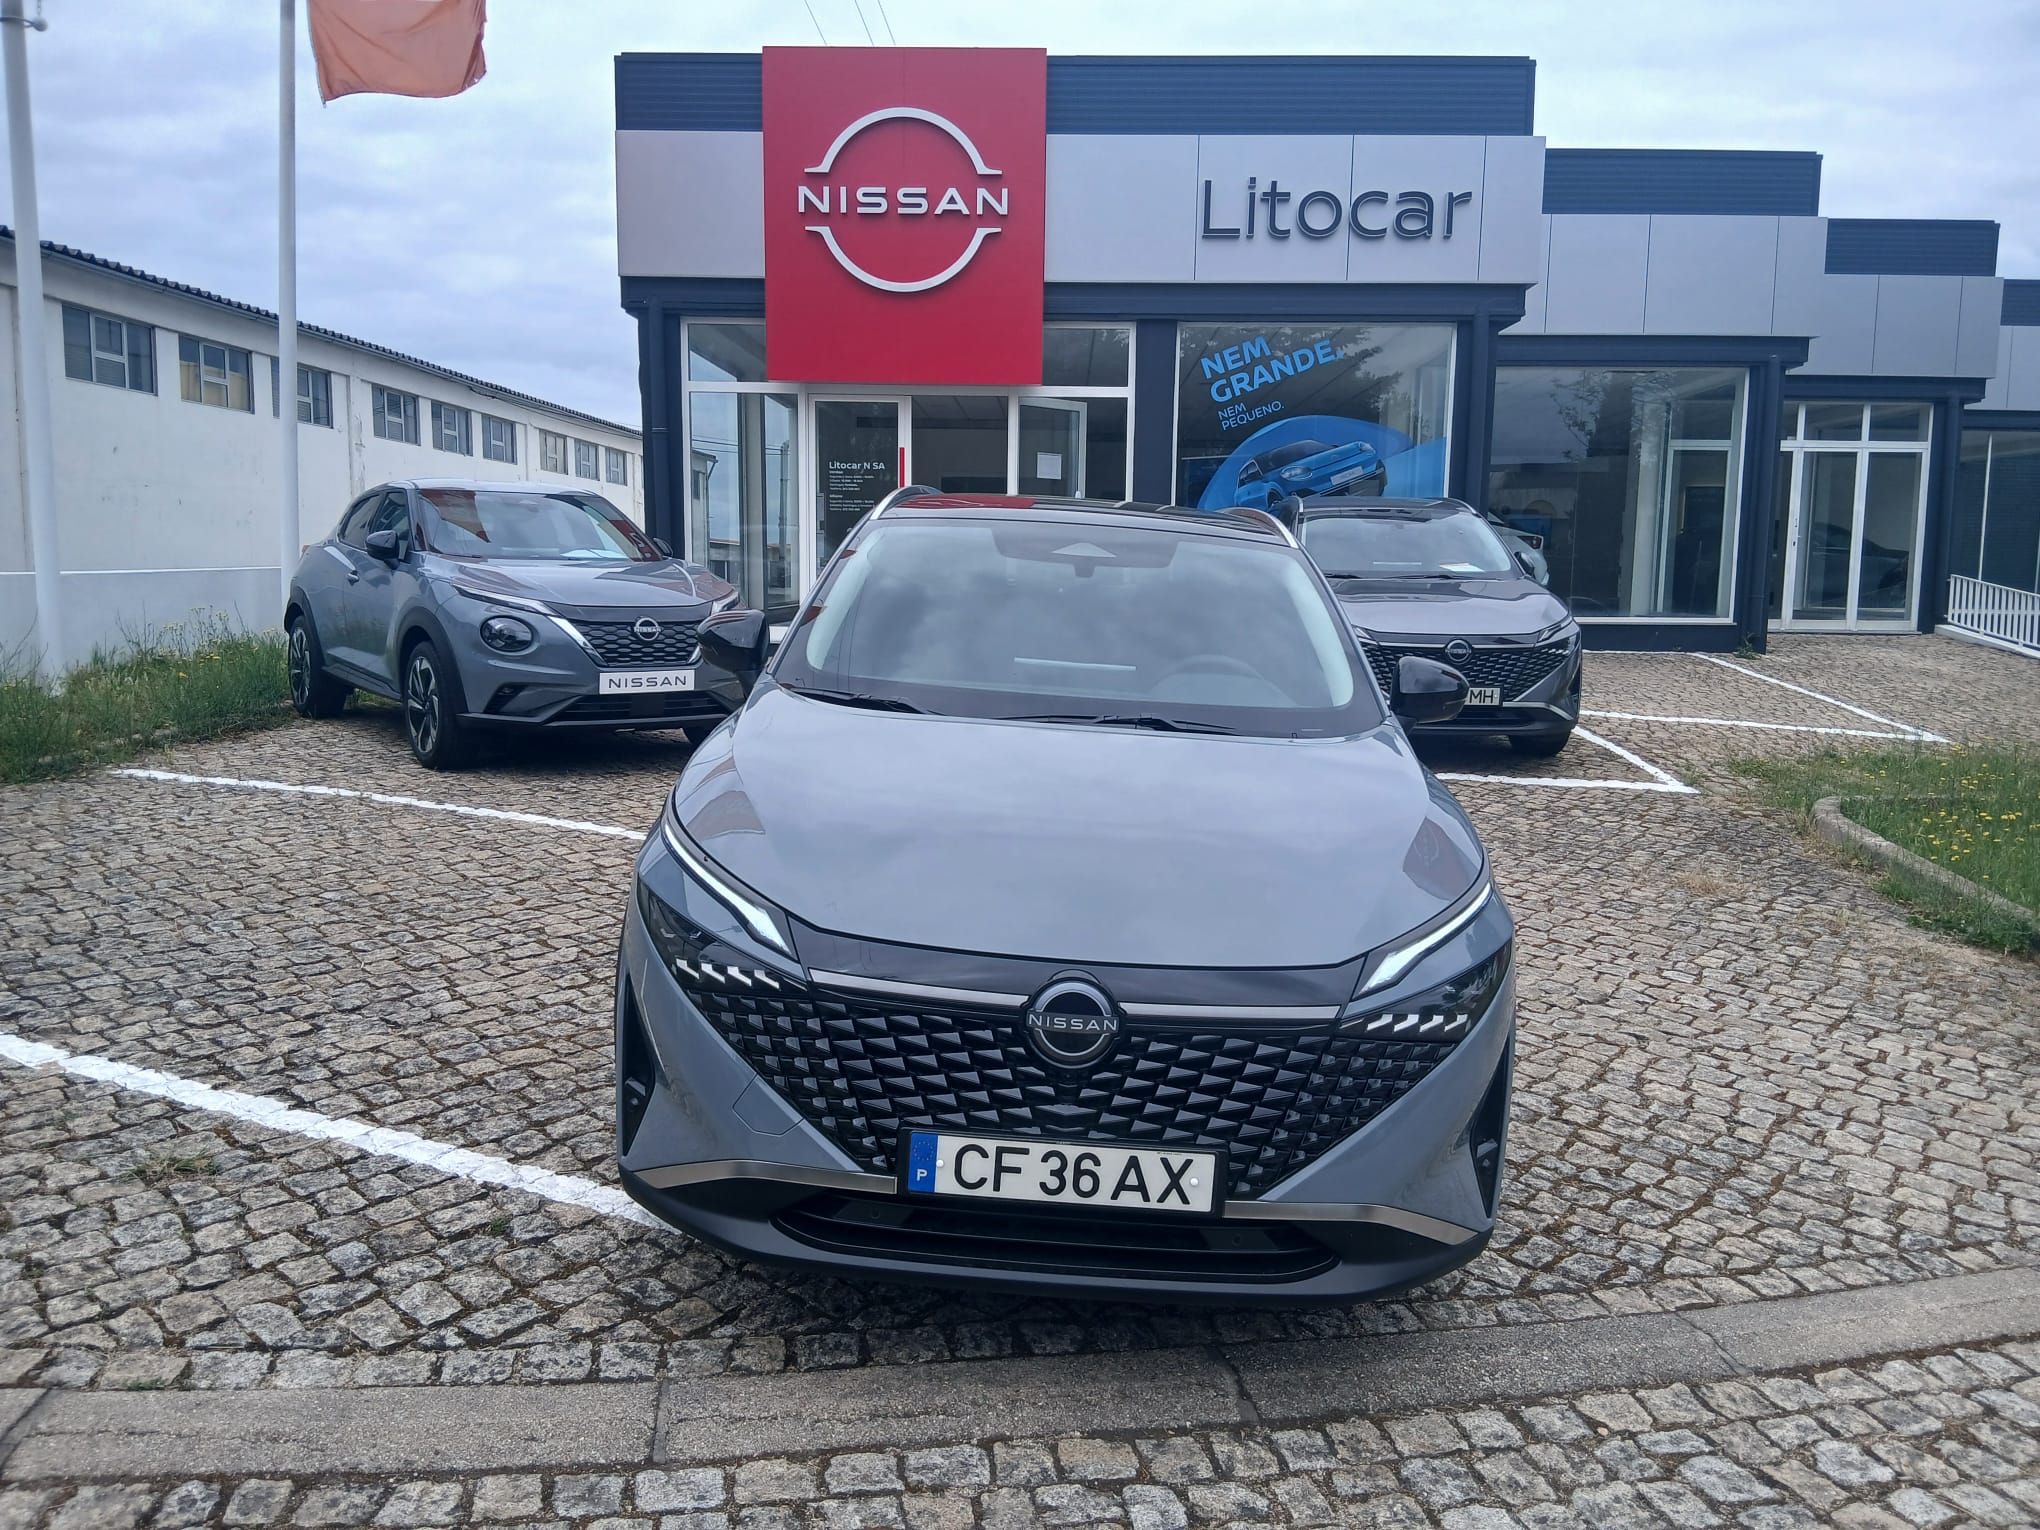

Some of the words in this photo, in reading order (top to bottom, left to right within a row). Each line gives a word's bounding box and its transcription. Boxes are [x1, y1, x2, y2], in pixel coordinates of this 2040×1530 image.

[798, 185, 1009, 216] NISSAN
[1202, 176, 1473, 240] Litocar
[1200, 336, 1271, 380] NEM
[1210, 339, 1345, 403] GRANDE.
[1217, 402, 1247, 421] NEM
[1221, 400, 1285, 431] PEQUENO.
[829, 461, 862, 470] Litocar
[872, 462, 885, 470] SA
[608, 675, 687, 689] NISSAN
[1469, 690, 1494, 704] MH
[1028, 1013, 1118, 1031] NISSAN
[916, 1168, 928, 1181] P
[954, 1144, 1030, 1192] CF
[1039, 1150, 1102, 1199] 36
[1110, 1155, 1194, 1206] AX
